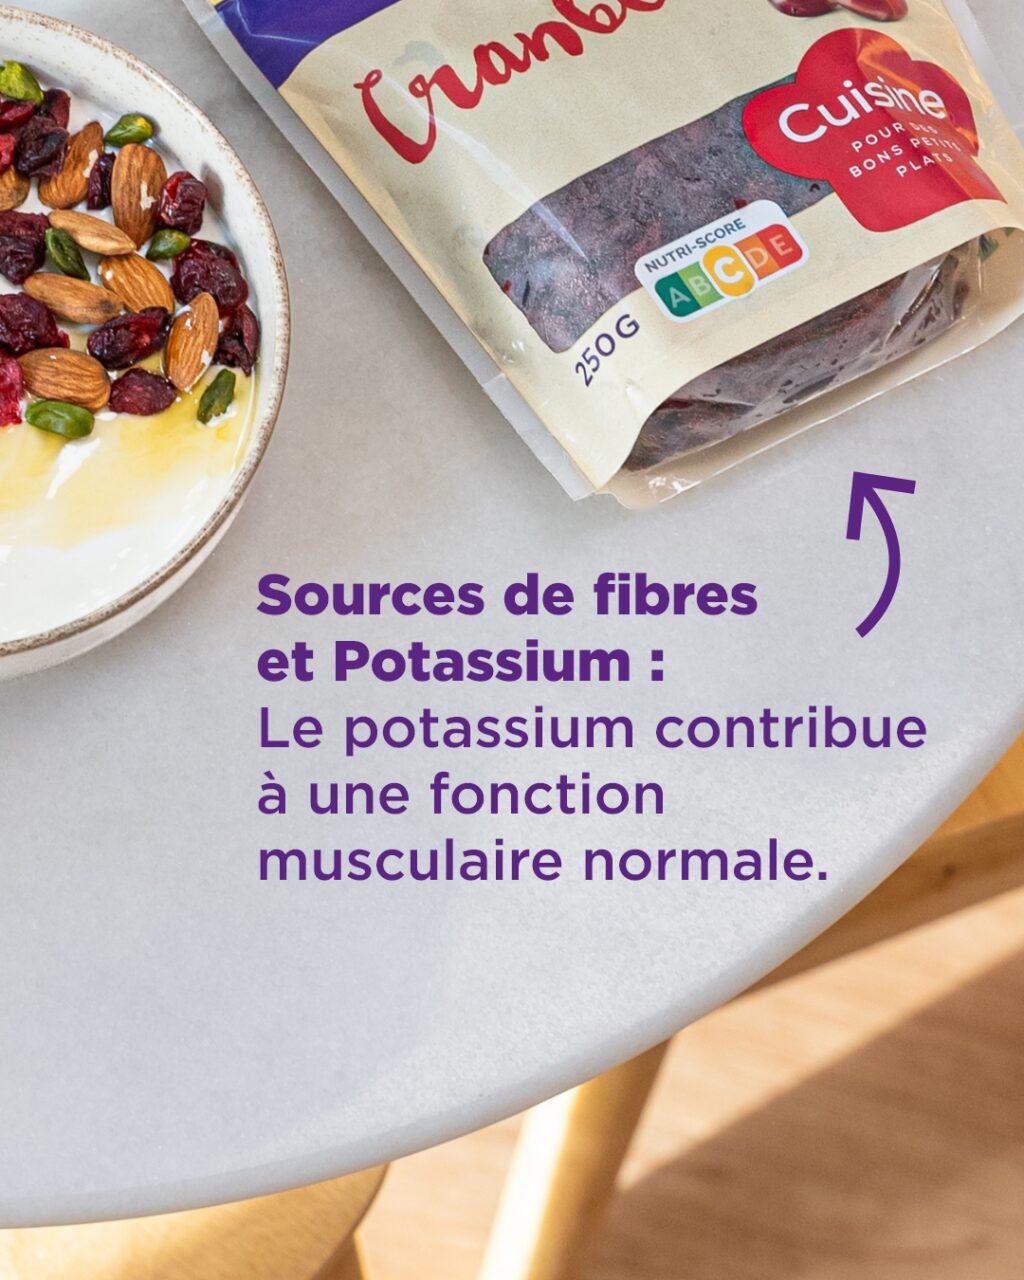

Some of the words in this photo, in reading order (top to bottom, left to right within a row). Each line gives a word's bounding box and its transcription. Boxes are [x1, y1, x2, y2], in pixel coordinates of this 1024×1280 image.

[778, 76, 946, 143] Cuisine
[851, 122, 905, 153] POUR
[848, 144, 904, 178] BONS
[895, 152, 953, 177] PLATS
[644, 217, 747, 273] NUTRI-SCORE
